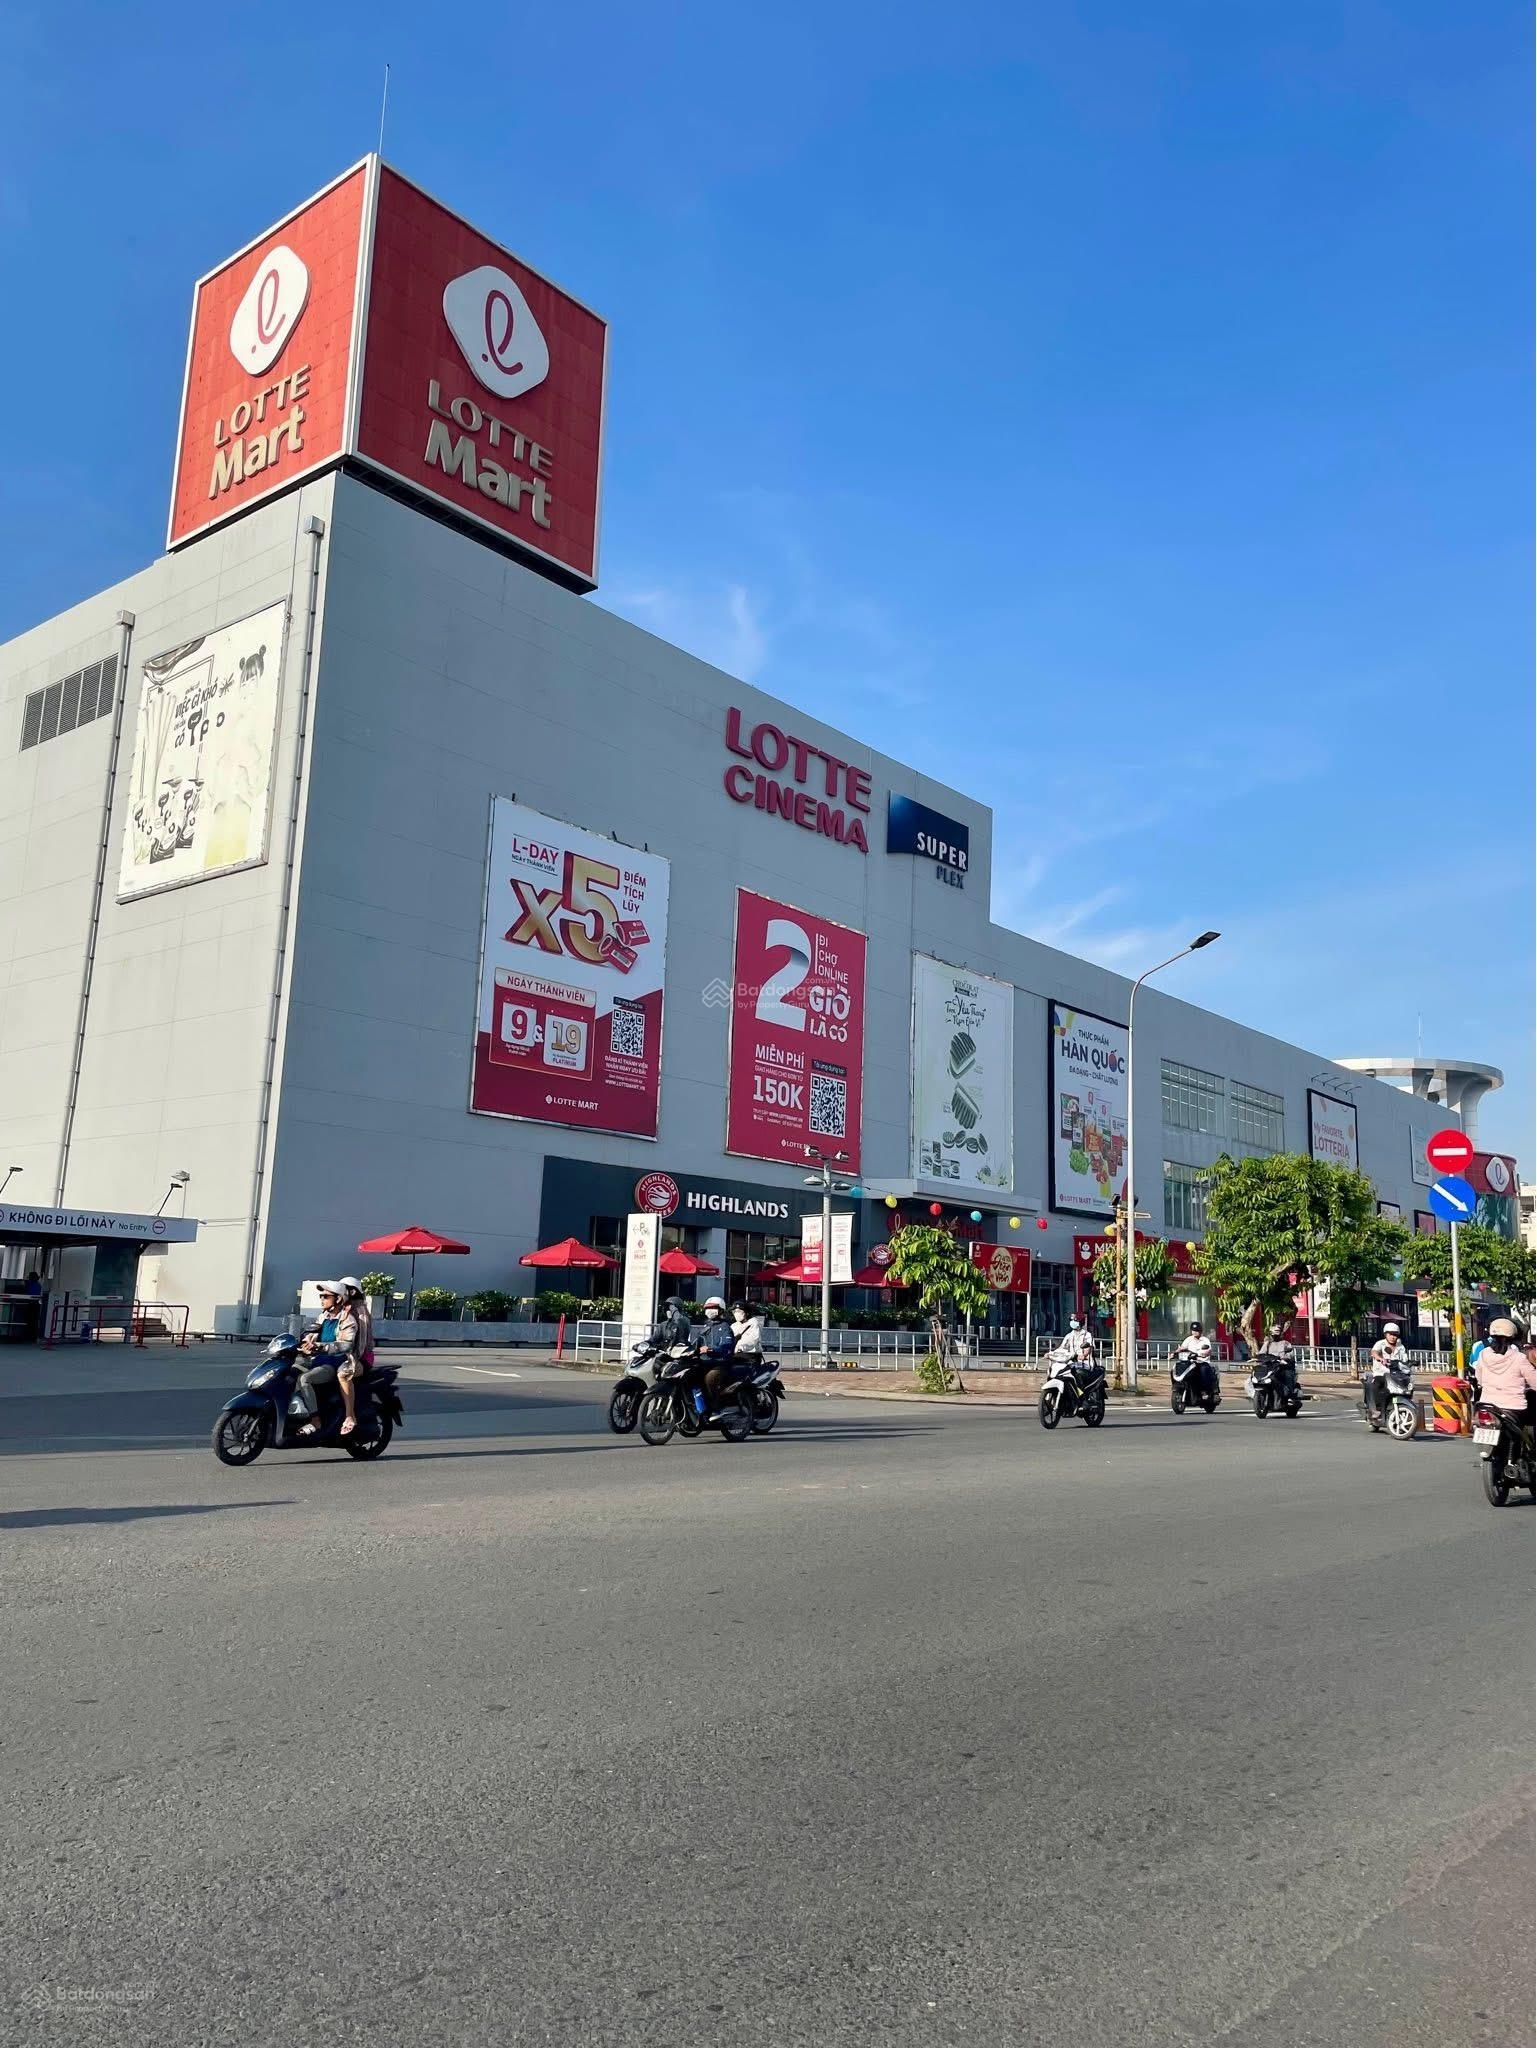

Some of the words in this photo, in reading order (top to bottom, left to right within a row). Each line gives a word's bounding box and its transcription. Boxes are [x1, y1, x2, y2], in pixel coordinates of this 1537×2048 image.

[215, 364, 311, 448] LOTTE
[427, 378, 553, 479] LOTTE
[208, 403, 306, 500] Mart
[423, 419, 551, 529] Mart
[724, 705, 872, 813] LOTTE
[723, 764, 870, 854] CINEMA
[513, 837, 559, 865] L-DAY
[916, 831, 968, 871] SUPER
[623, 871, 647, 888] ĐIỂM
[936, 864, 965, 890] PLEX
[622, 885, 645, 901] TÍCH
[622, 899, 640, 915] LŨY
[819, 935, 829, 948] ĐI
[818, 950, 839, 968] CHỢ
[754, 918, 812, 1032] 2
[818, 964, 849, 985] ONLINE
[507, 974, 534, 991] NGÀY
[535, 981, 565, 999] THÀNH
[566, 989, 586, 1004] VIÊN
[809, 983, 851, 1021] GIỜ
[511, 1009, 528, 1041] 9
[532, 1024, 544, 1043] &
[551, 1020, 582, 1055] 19
[809, 1014, 828, 1038] LÀ
[829, 1020, 849, 1043] CÓ
[552, 1057, 577, 1067] PLATINUM
[755, 1043, 785, 1064] MIỄN
[786, 1051, 805, 1069] PHÍ
[1062, 1036, 1089, 1064] HÀN
[1091, 1049, 1125, 1075] QUỐC
[553, 1097, 577, 1109] LOTTE
[577, 1099, 599, 1111] MART
[753, 1074, 804, 1111] 150K
[786, 1141, 803, 1150] LOTTE
[1313, 1135, 1351, 1159] LOTTERIA
[641, 1175, 677, 1196] HIGHLANDS
[687, 1192, 789, 1219] HIGHLANDS
[8, 1210, 53, 1226] KHÔNG
[54, 1215, 68, 1227] ĐI
[69, 1214, 89, 1229] LỐI
[90, 1214, 116, 1230] NÀY
[118, 1221, 129, 1231] No
[129, 1223, 148, 1233] Entry
